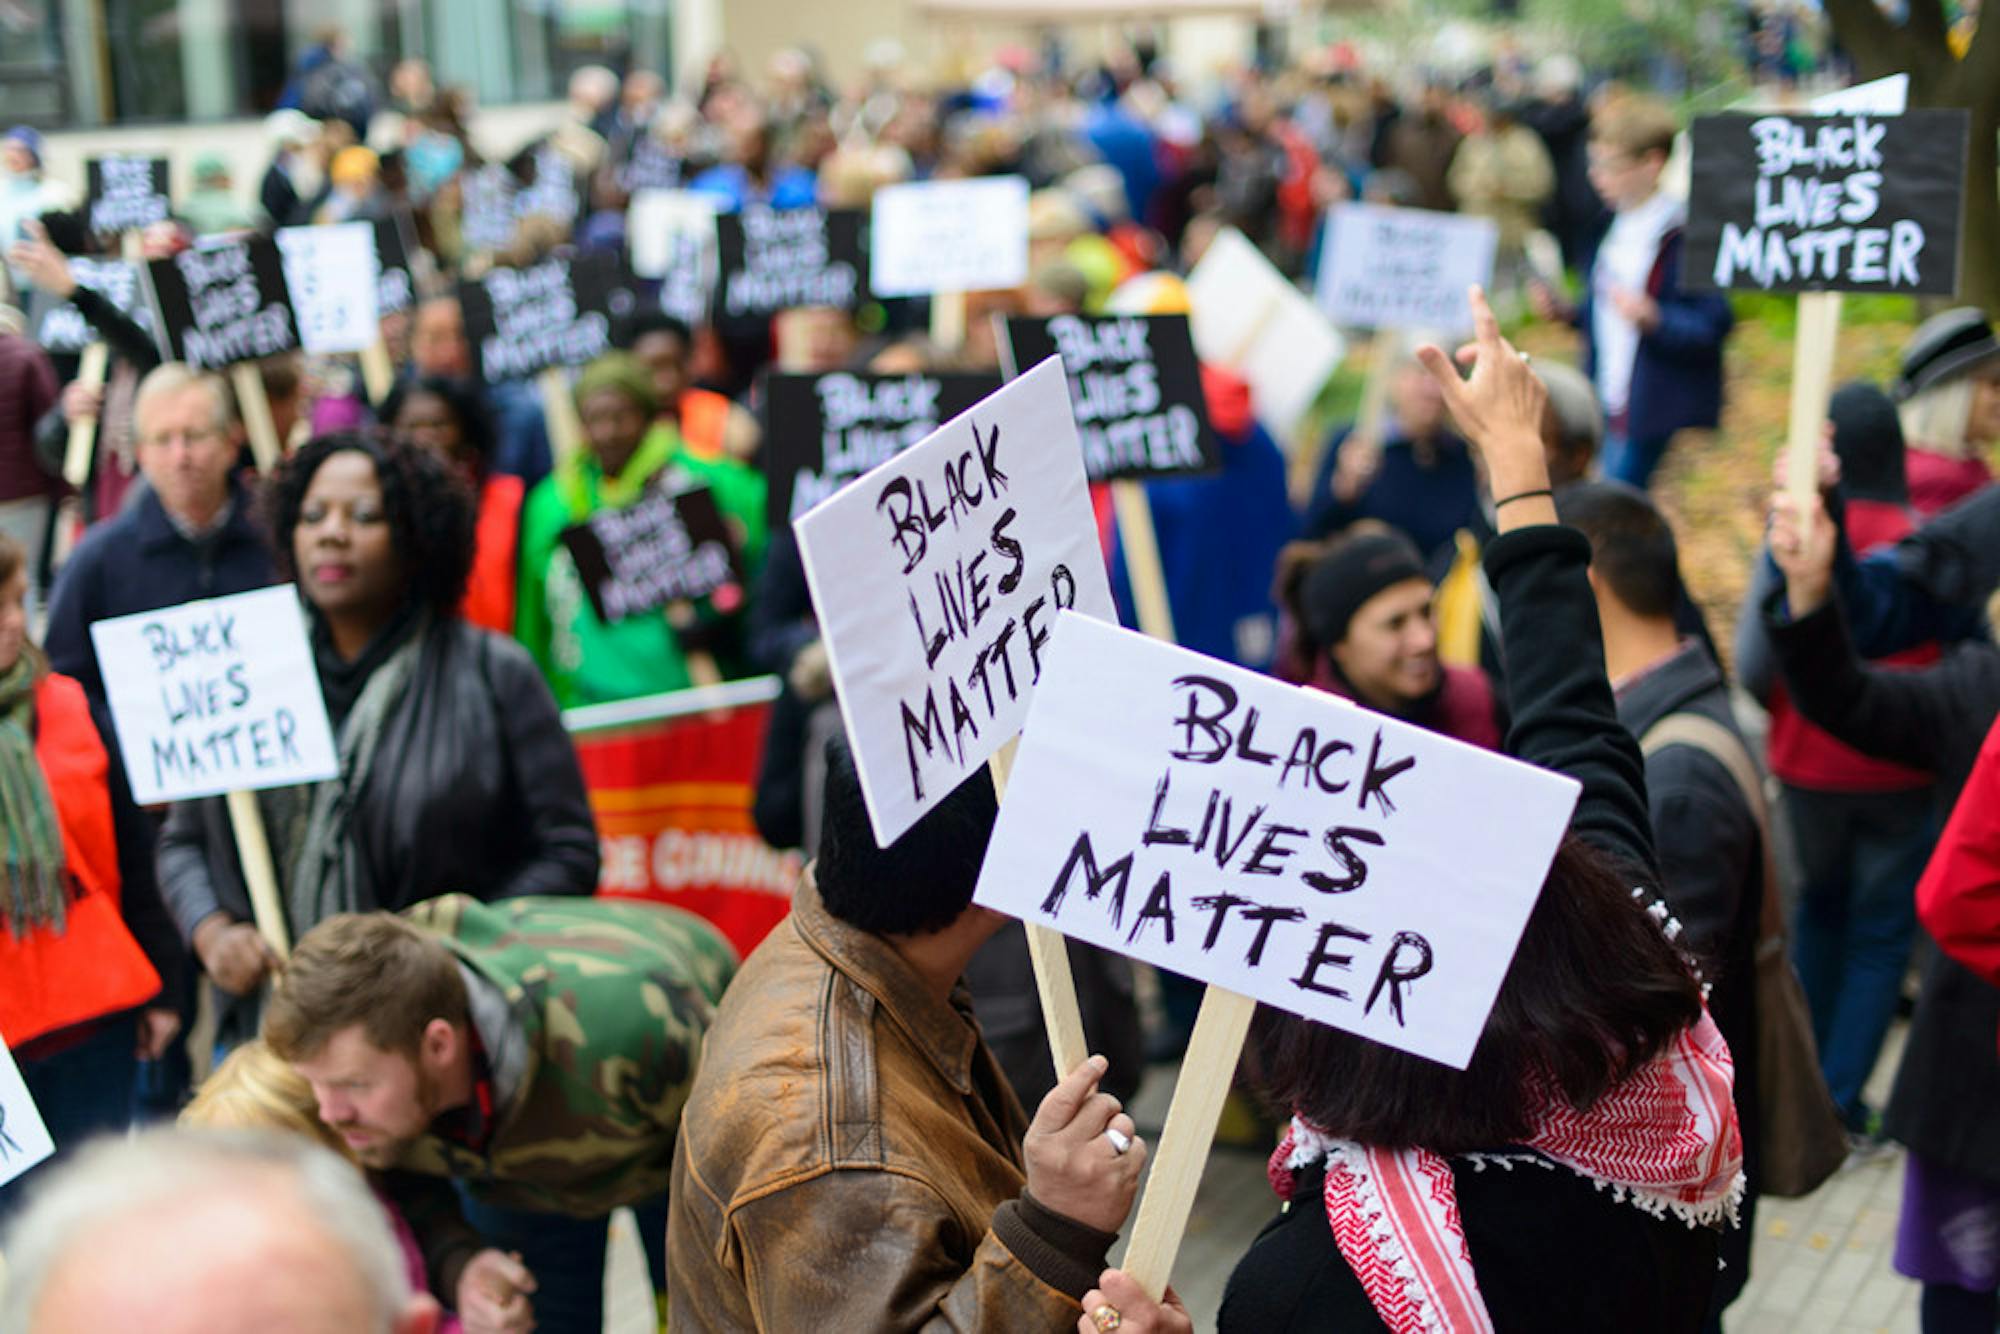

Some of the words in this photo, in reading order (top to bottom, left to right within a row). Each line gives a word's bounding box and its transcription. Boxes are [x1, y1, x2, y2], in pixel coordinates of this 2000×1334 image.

[1751, 115, 1886, 177] BLACK
[1755, 171, 1883, 229] LIVES
[1713, 219, 1925, 288] MATTER
[1046, 315, 1153, 374] BLACK
[815, 372, 941, 431] BLACK
[1077, 403, 1204, 480] ATTER
[877, 419, 1008, 575] BLACK
[908, 507, 1023, 670] LIVES
[142, 610, 236, 671] BLACK
[162, 665, 250, 725] LIVES
[151, 708, 302, 788] MATTER
[1168, 675, 1415, 816] BLACK
[1142, 769, 1385, 893] LIVES
[1041, 831, 1432, 1027] MATTER
